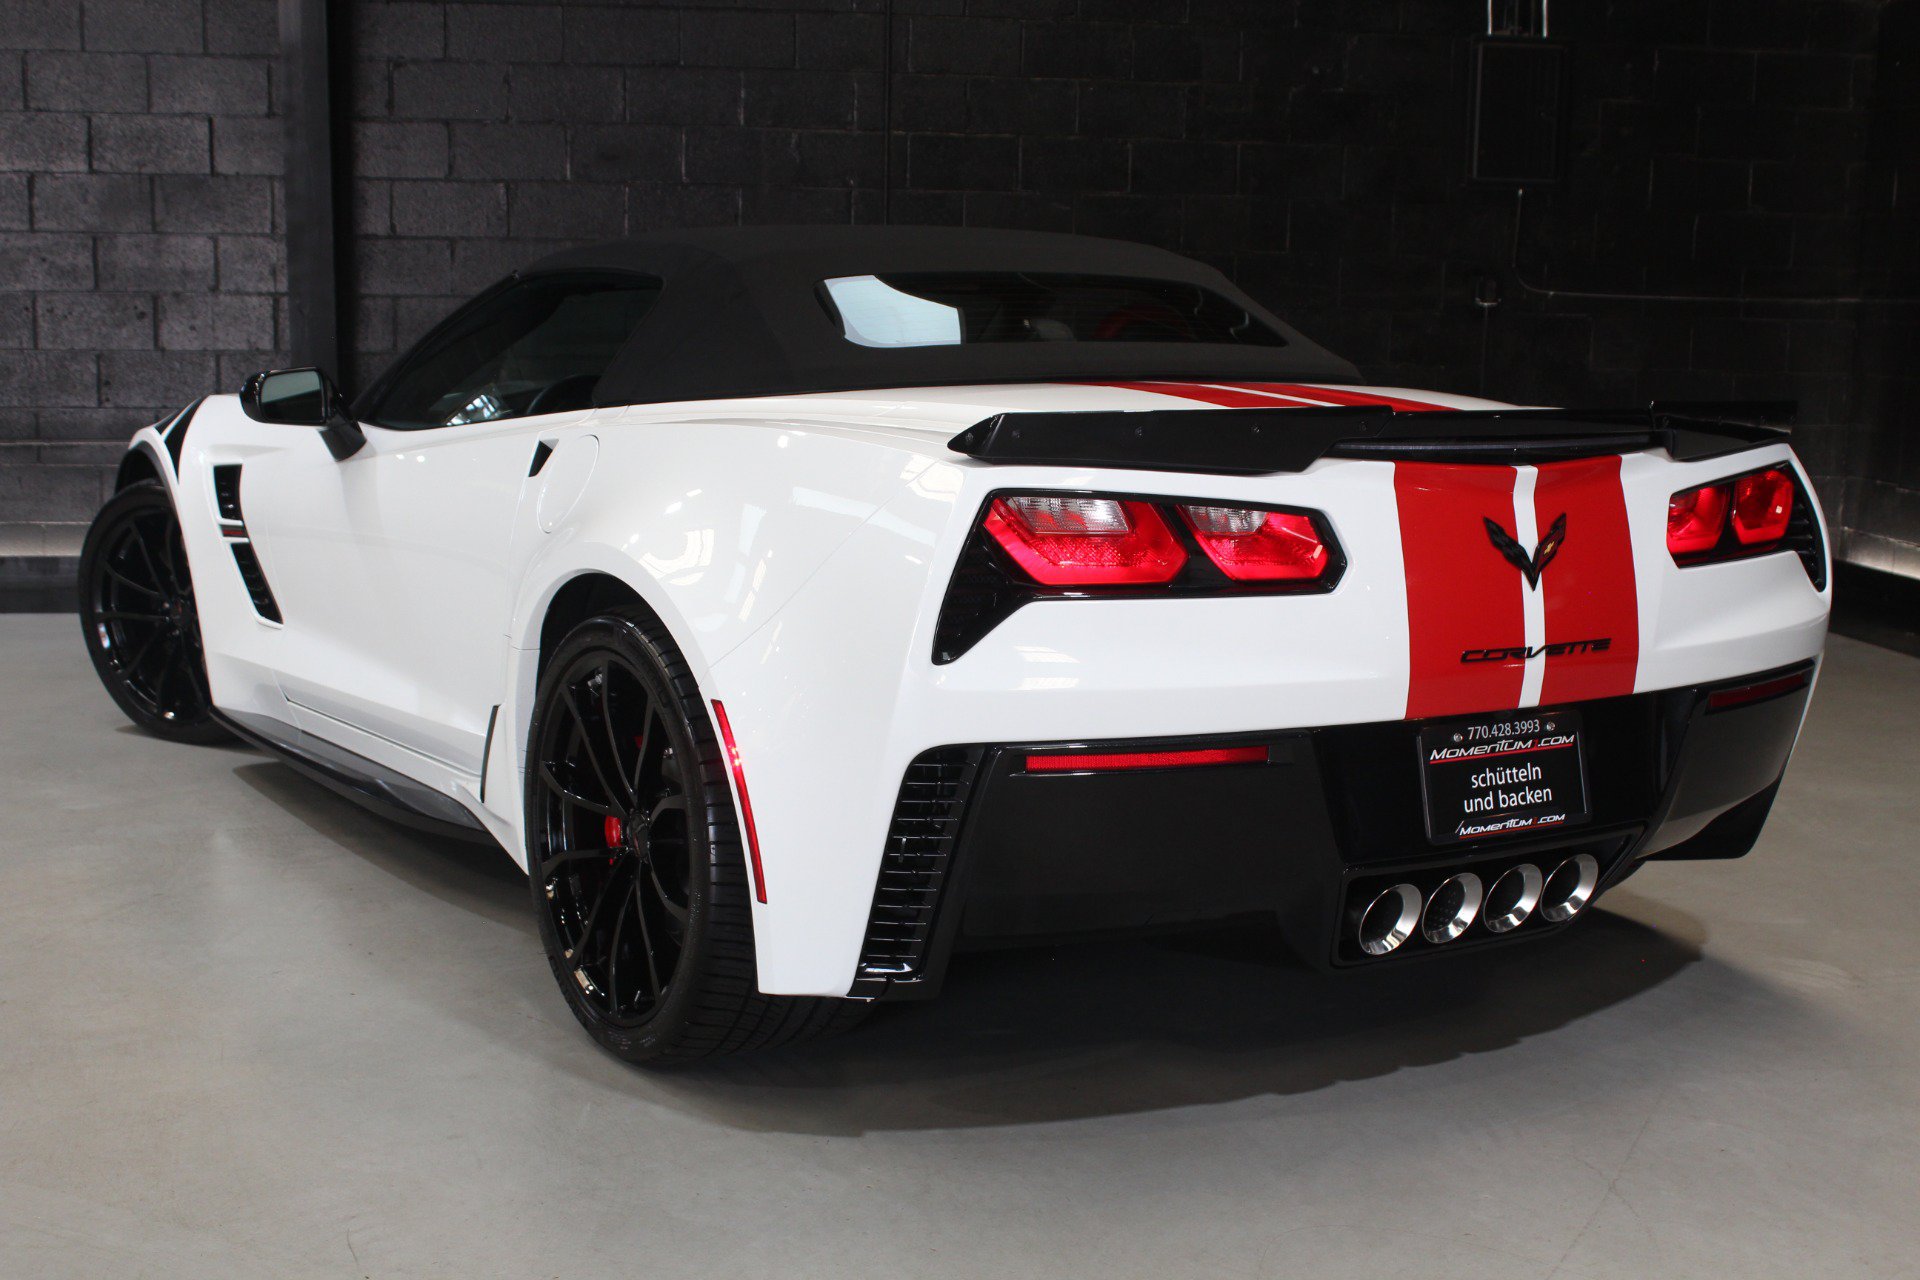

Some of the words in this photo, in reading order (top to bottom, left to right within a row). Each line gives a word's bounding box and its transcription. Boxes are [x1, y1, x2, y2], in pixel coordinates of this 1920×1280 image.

[1461, 638, 1612, 663] CORVETTE
[1467, 719, 1540, 740] 770.428.3993
[1471, 763, 1542, 789] schütteln
[1464, 791, 1494, 813] und
[1499, 786, 1552, 809] backen
